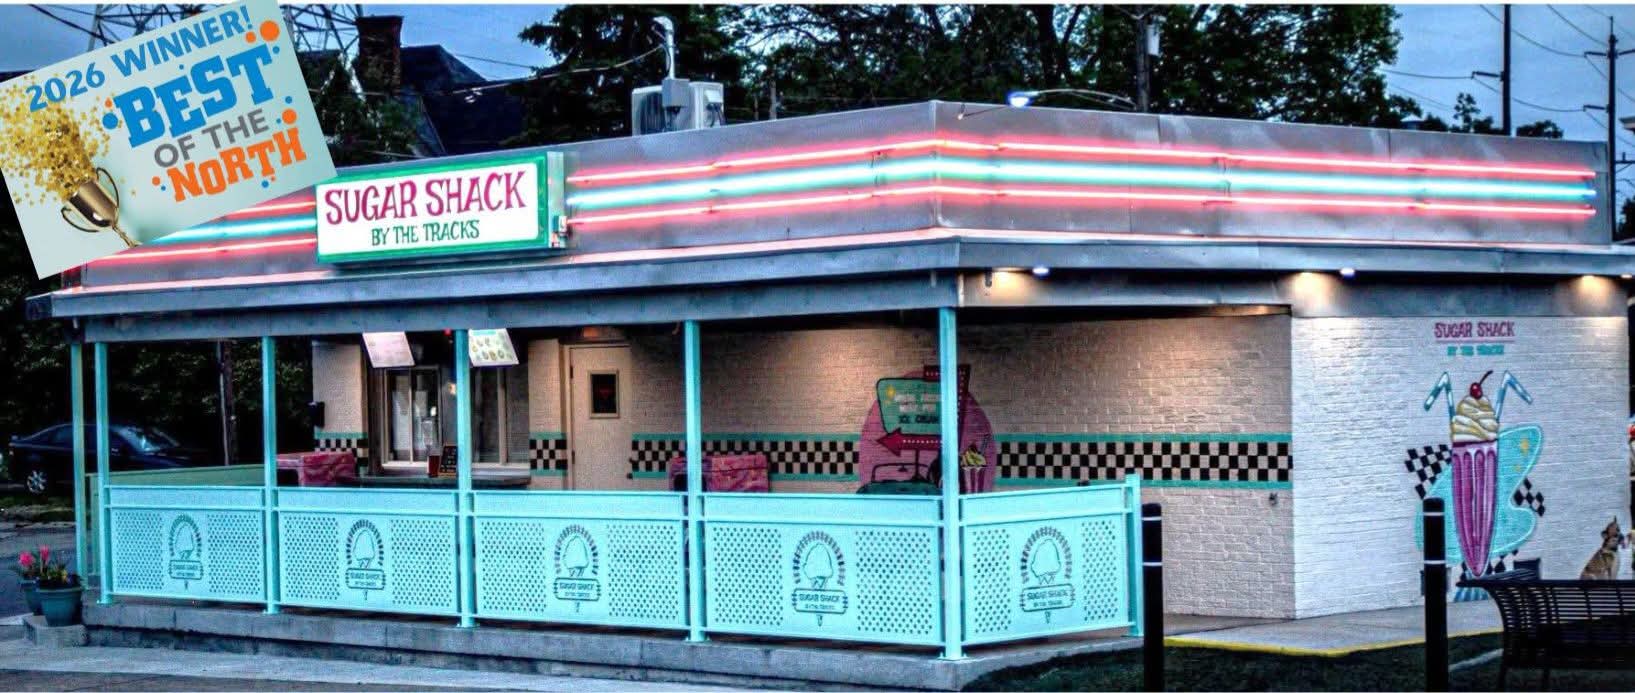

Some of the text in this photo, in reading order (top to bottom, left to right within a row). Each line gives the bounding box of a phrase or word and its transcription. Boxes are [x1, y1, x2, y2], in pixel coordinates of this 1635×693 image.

[324, 170, 527, 226] SUGAR SHACK
[371, 219, 480, 247] BY THE TRACKS
[1434, 321, 1515, 339] SUGAR SHACK
